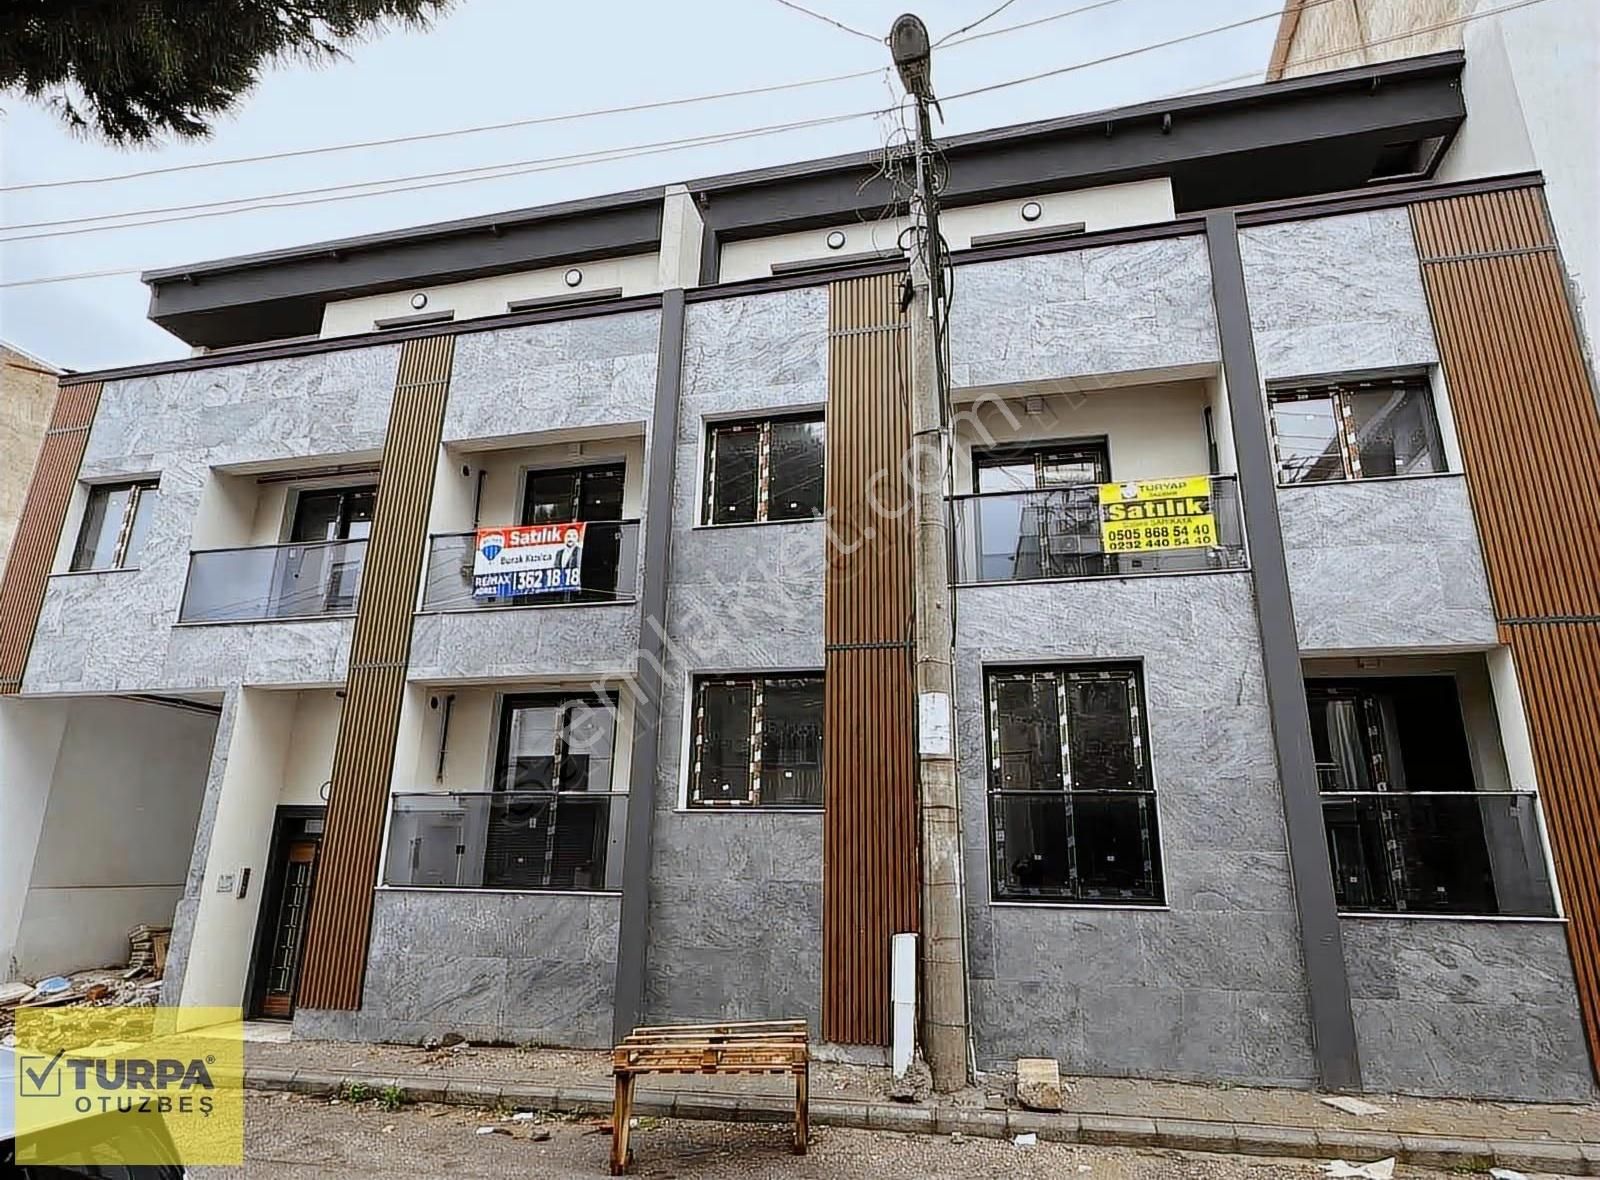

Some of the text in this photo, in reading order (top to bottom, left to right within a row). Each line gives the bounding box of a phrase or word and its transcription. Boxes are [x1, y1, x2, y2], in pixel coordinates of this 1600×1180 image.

[1138, 481, 1187, 493] TURYAP
[1108, 528, 1141, 541] 0505
[1173, 525, 1188, 537] 54
[1193, 523, 1210, 535] 40
[1109, 536, 1211, 550] 0232 440 54 40
[517, 568, 580, 590] 362 18 18
